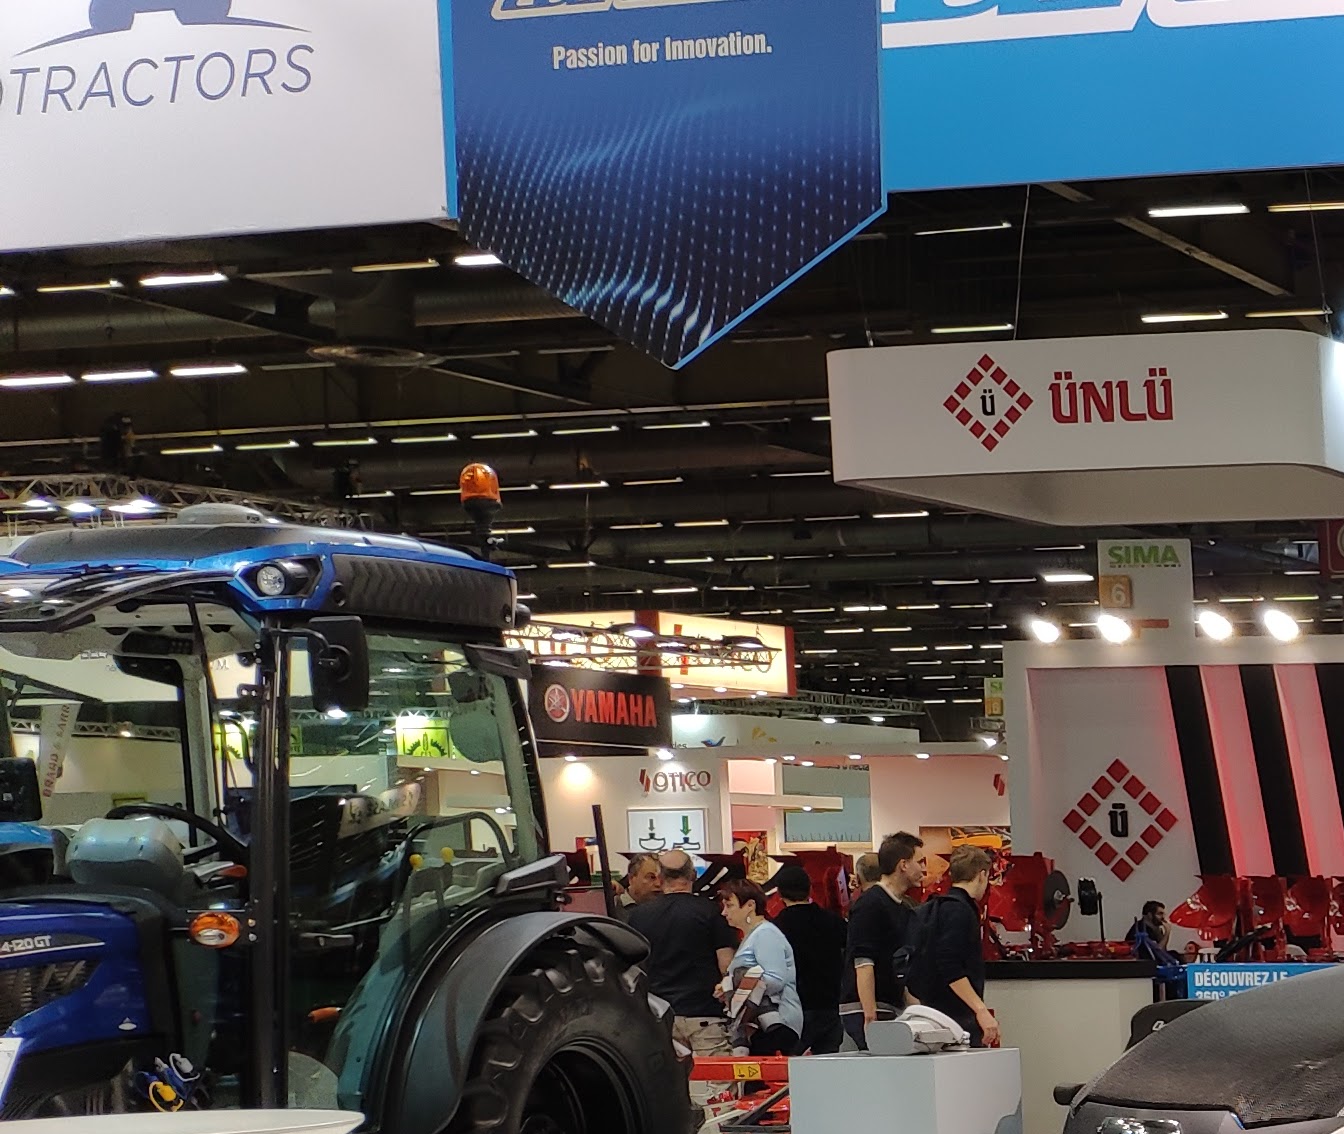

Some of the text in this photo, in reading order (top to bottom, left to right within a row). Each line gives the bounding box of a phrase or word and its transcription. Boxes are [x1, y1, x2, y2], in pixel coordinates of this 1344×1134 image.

[552, 31, 773, 70] Passion for Innovation.
[0, 44, 315, 116] TRACTORS
[1048, 367, 1174, 424] ÜNLÜ
[1107, 545, 1180, 565] SIMA
[1110, 583, 1127, 605] 6
[570, 687, 658, 728] YAMAHA
[1194, 968, 1270, 987] DÉCOUVREZ
